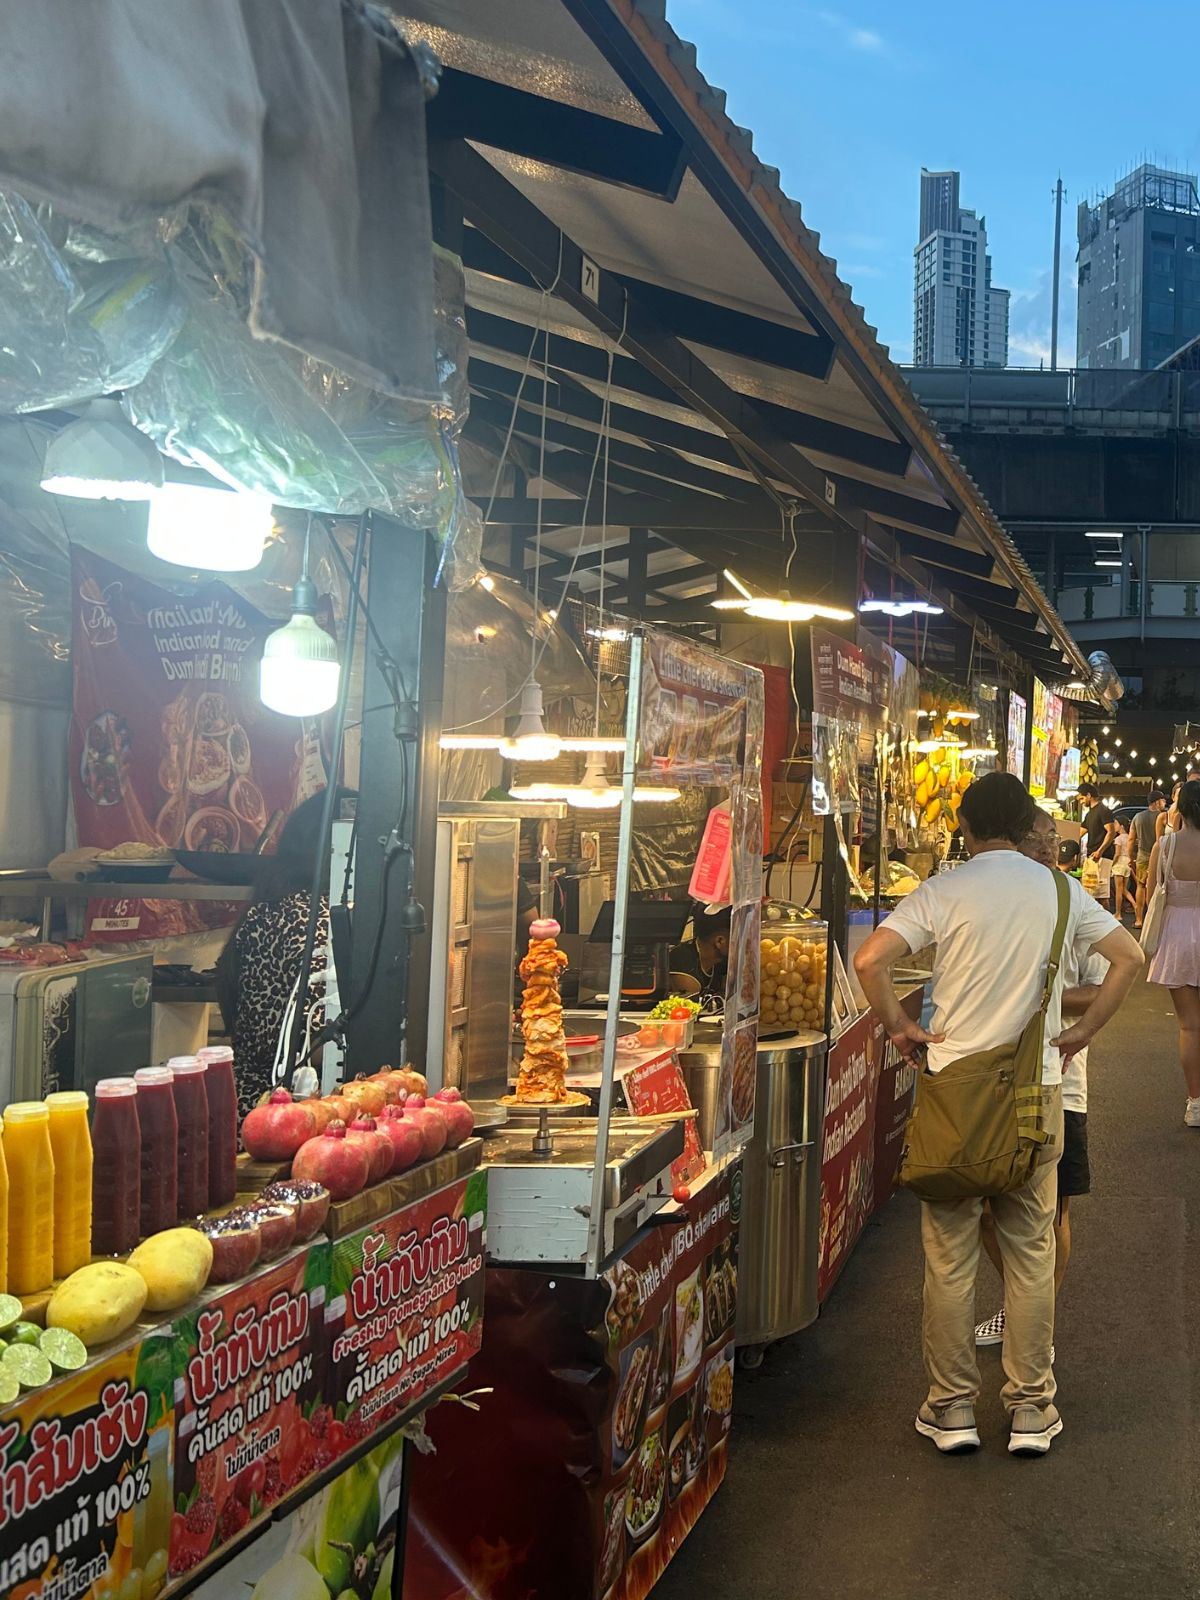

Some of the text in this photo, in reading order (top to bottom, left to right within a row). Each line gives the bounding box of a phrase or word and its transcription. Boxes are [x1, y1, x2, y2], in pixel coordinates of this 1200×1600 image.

[586, 265, 595, 291] 71
[114, 899, 129, 916] 45
[351, 1216, 470, 1320] น้ำทับทิม
[636, 1260, 660, 1306] Little
[332, 1253, 482, 1364] Freshly Pomegrante Juice
[406, 1317, 433, 1361] แท้
[434, 1296, 471, 1345] 100%
[188, 1291, 309, 1405] น้ำทับทิม
[399, 1376, 411, 1393] No
[411, 1358, 435, 1386] Sugar
[247, 1374, 273, 1423] แท้
[275, 1353, 313, 1404] 100%
[55, 1493, 91, 1553] แท้
[96, 1463, 150, 1528] 100%
